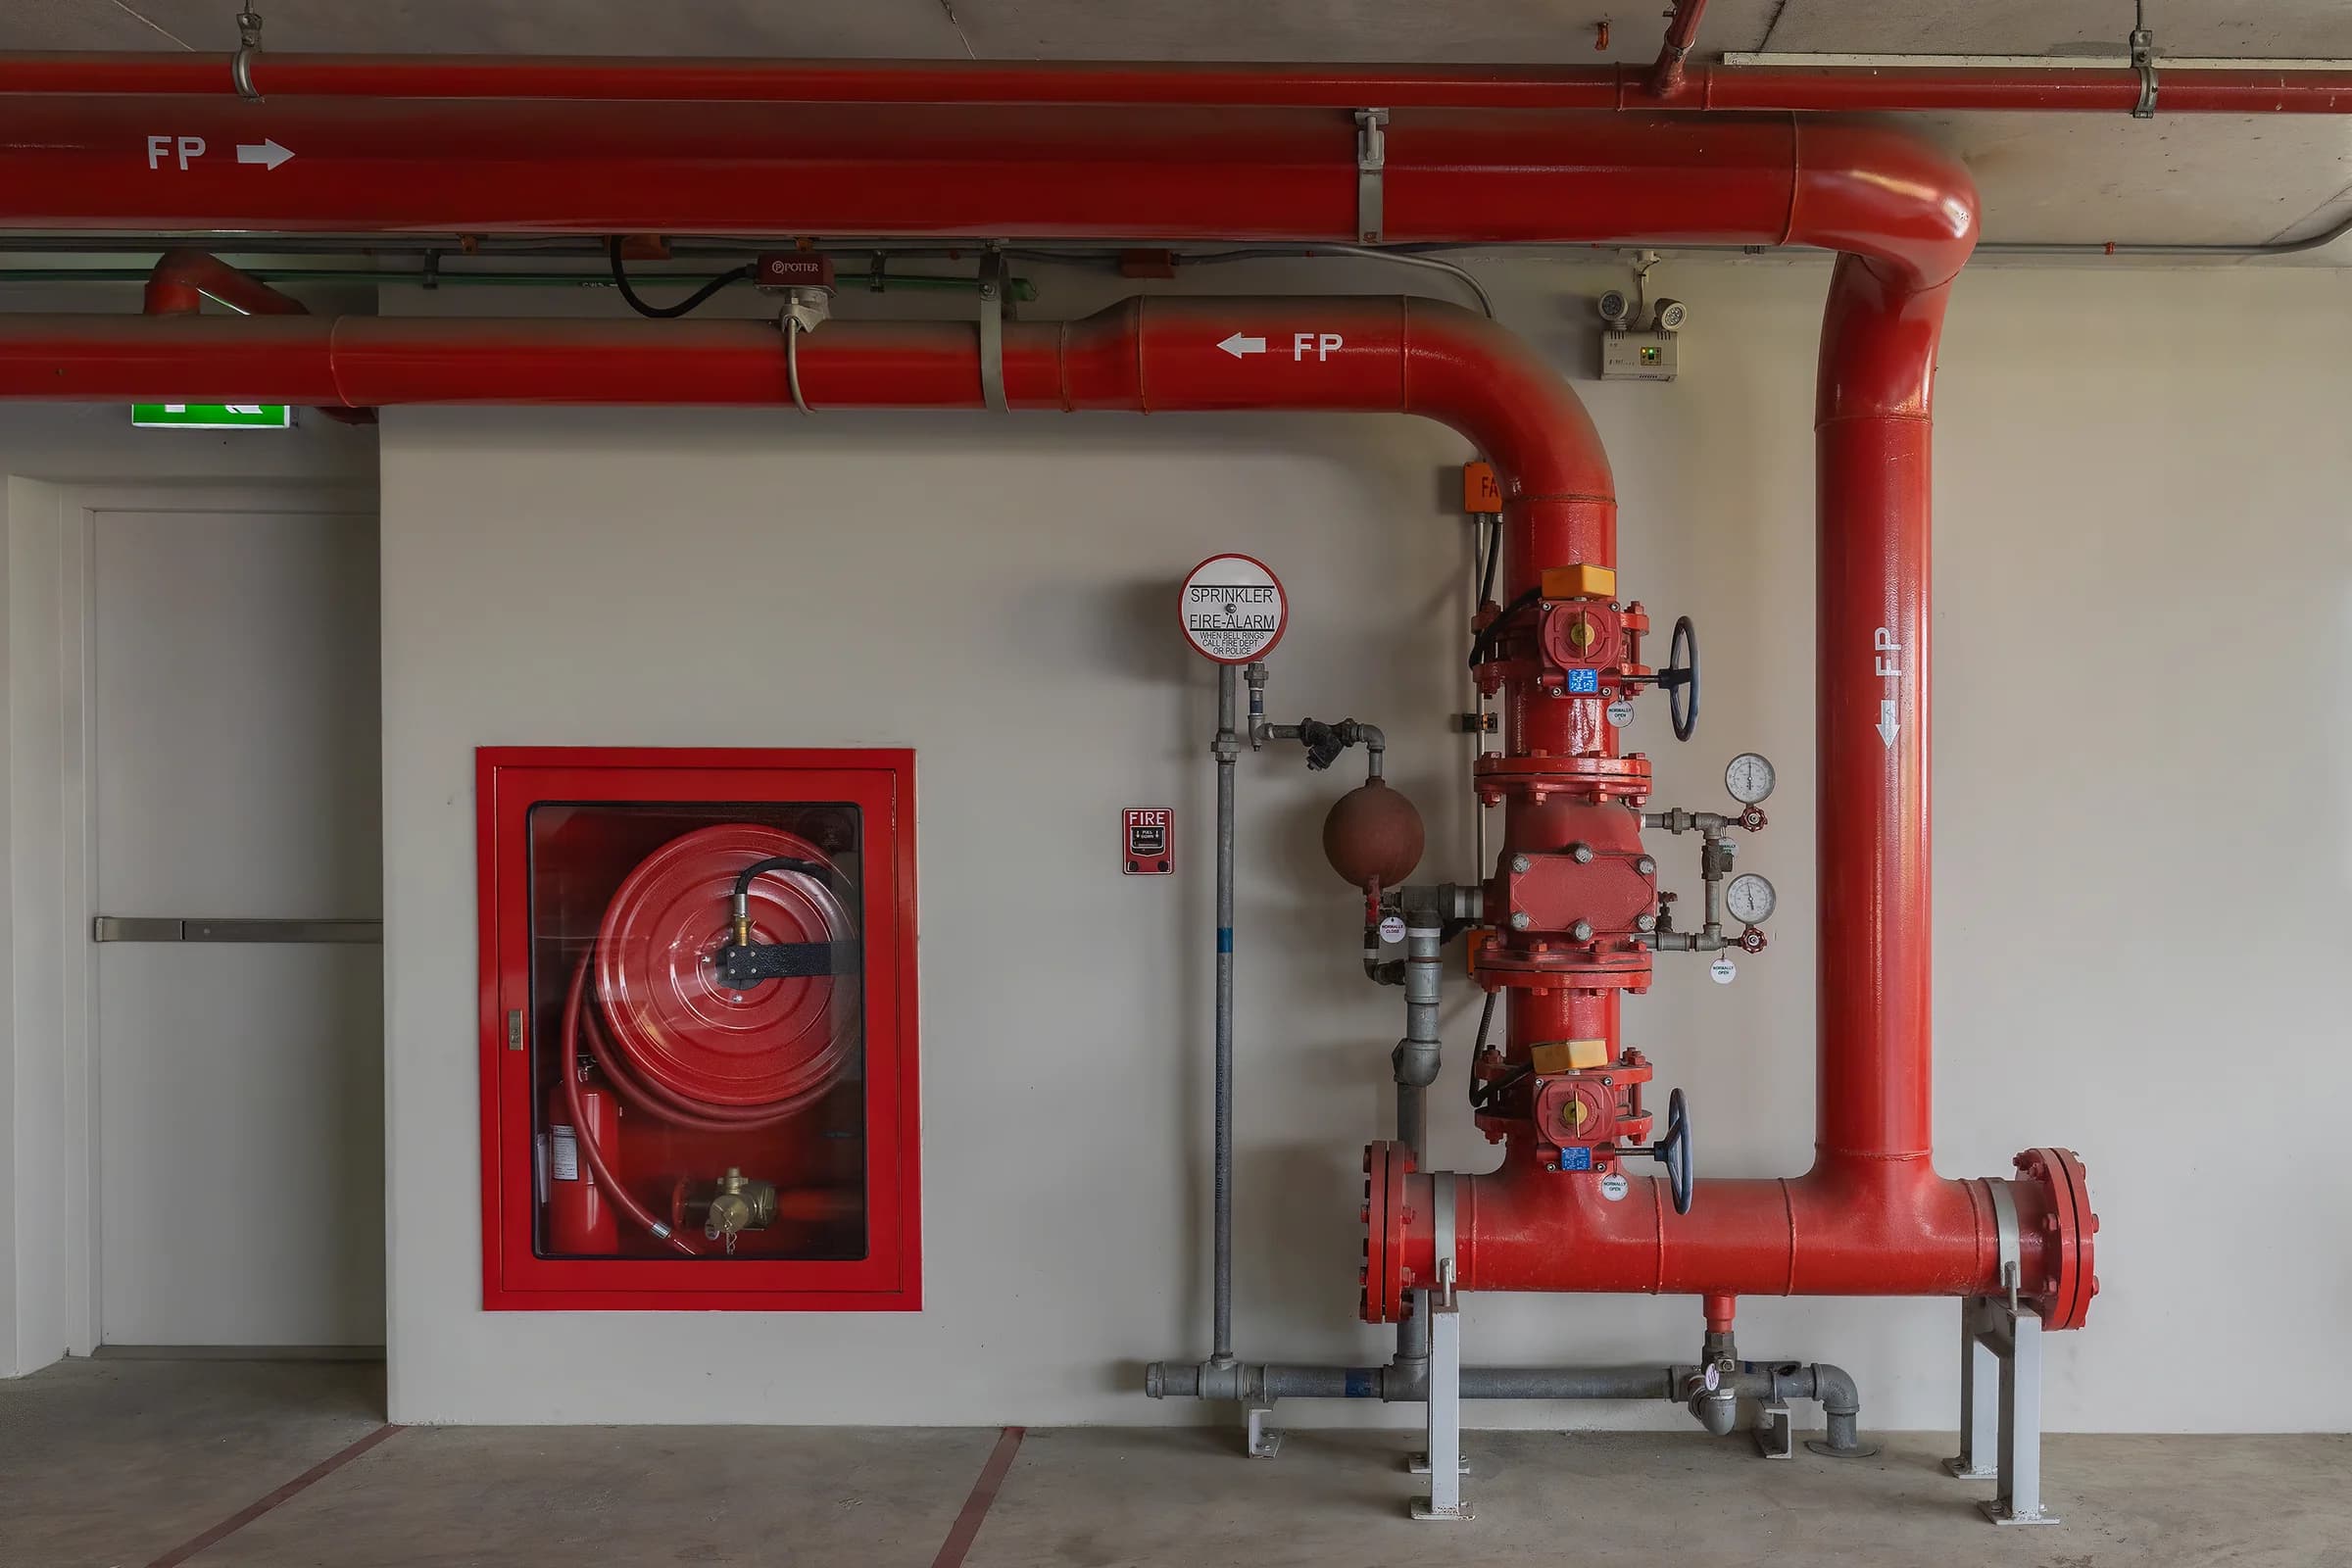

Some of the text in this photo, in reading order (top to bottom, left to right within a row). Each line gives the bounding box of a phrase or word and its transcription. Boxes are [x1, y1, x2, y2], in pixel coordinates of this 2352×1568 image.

[148, 135, 207, 171] FP
[785, 263, 819, 272] POTTER
[1294, 332, 1344, 362] FP
[1482, 476, 1499, 498] FA
[1191, 588, 1273, 603] SPRINKLER
[1874, 626, 1902, 676] FP
[1129, 811, 1165, 825] FIRE
